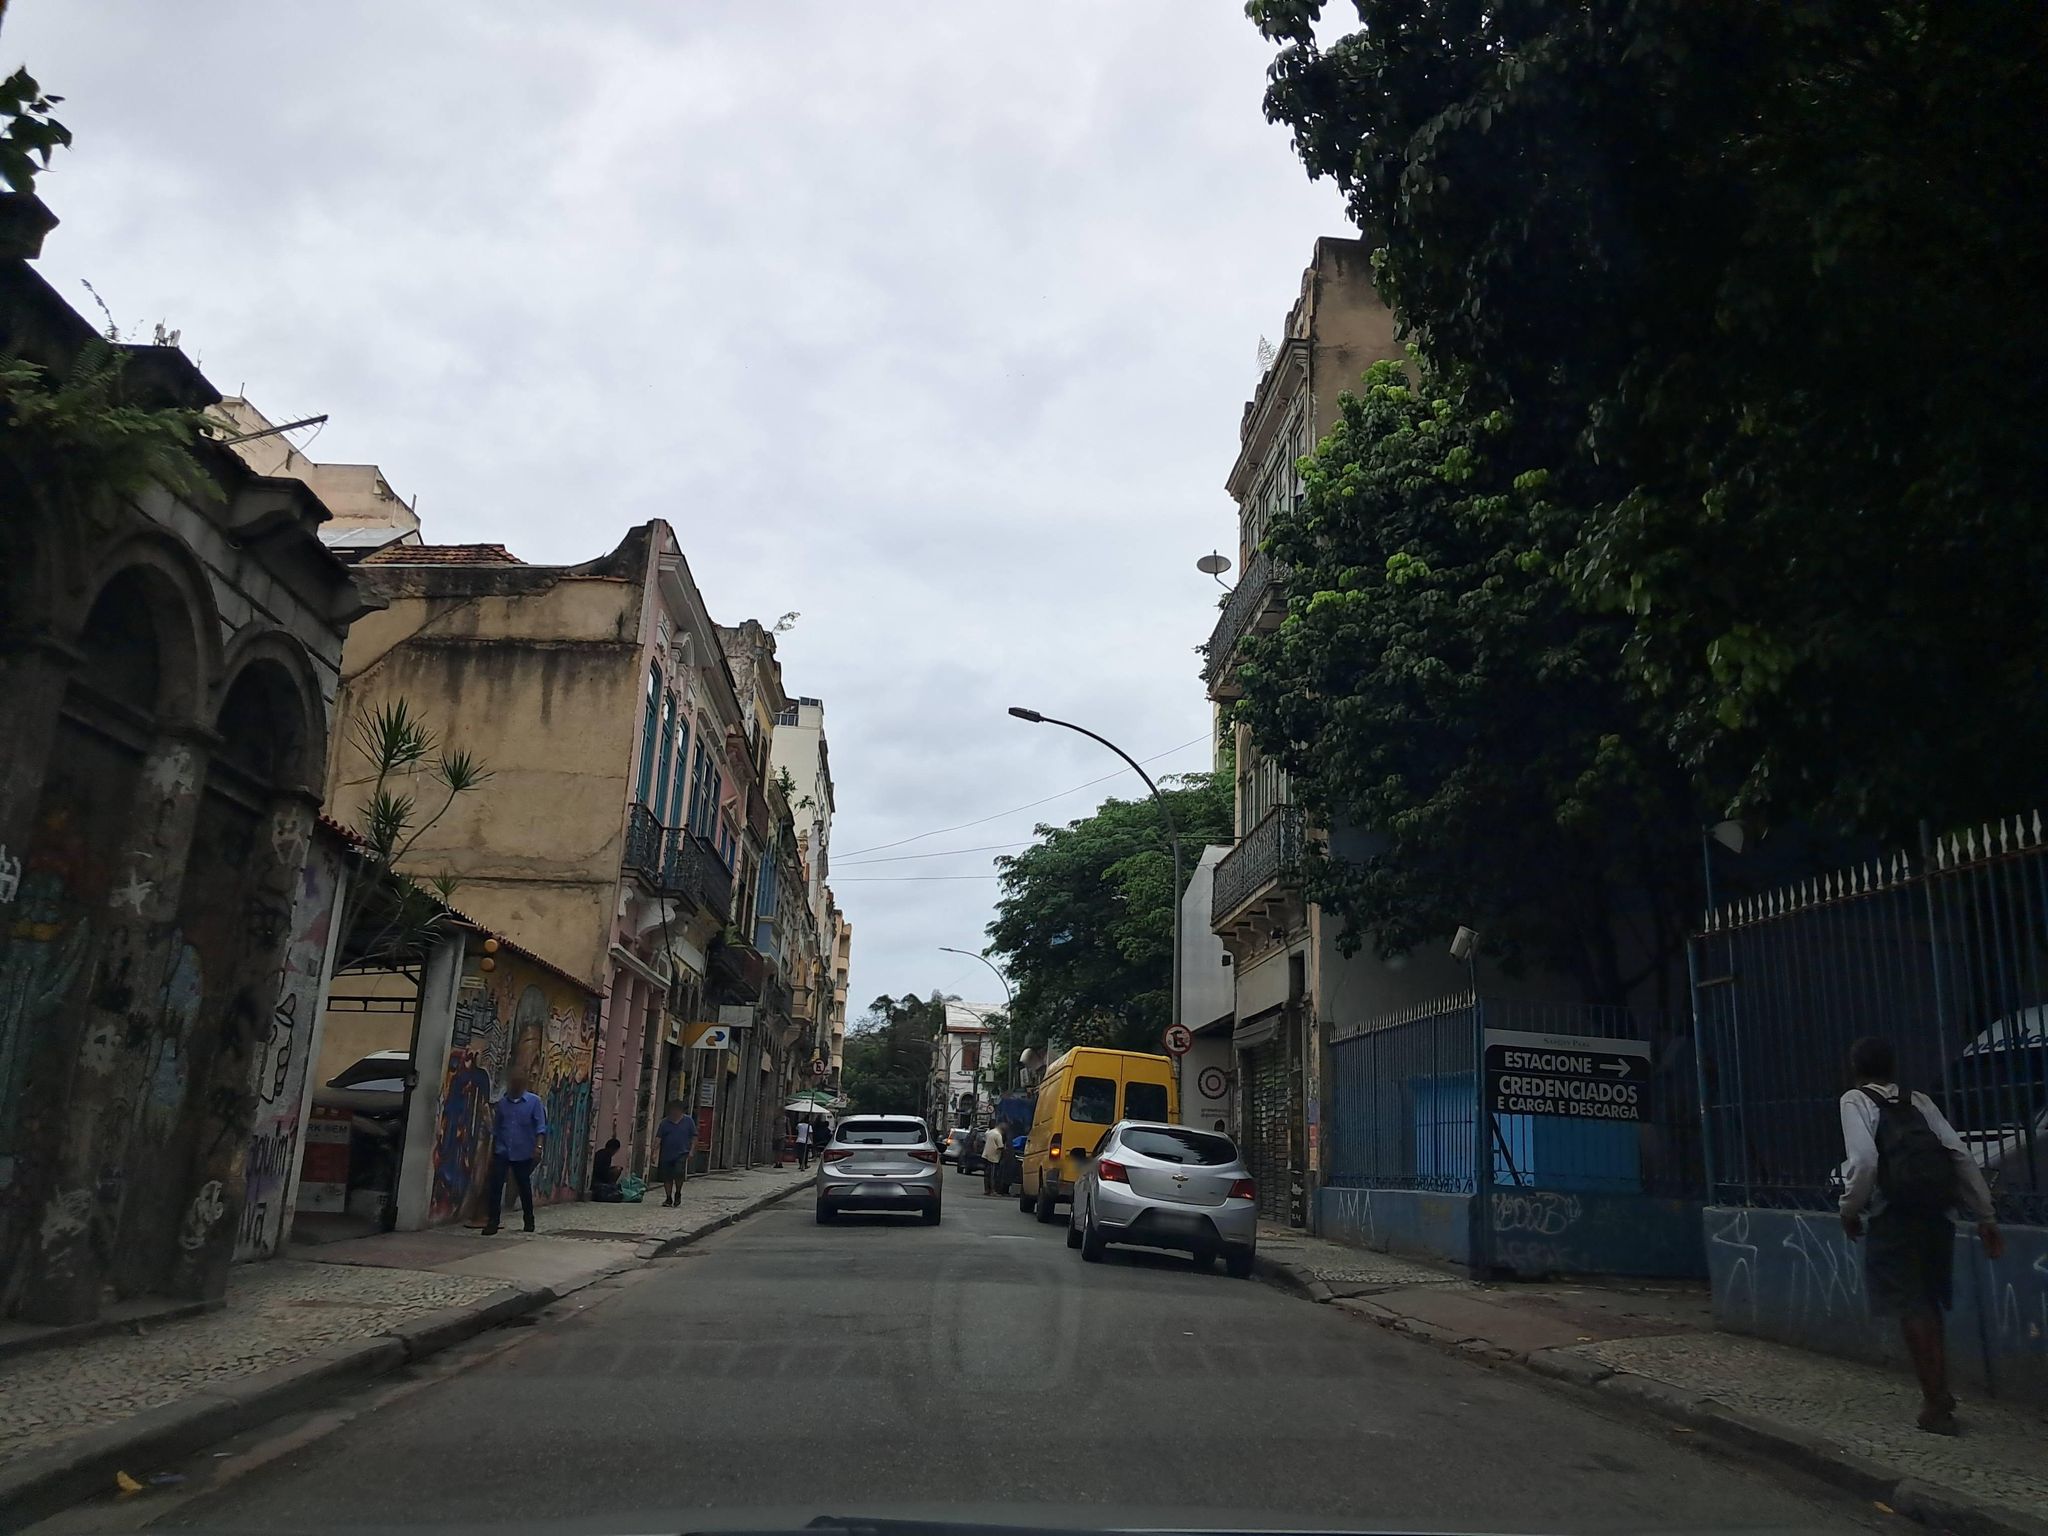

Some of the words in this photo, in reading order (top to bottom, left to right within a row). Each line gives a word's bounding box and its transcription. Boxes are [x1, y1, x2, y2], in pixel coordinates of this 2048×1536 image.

[1504, 1051, 1592, 1073] ESTACIONE
[1499, 1075, 1638, 1104] CREDENCIADOS
[1497, 1095, 1505, 1110] E
[1509, 1096, 1554, 1113] CARGA
[1558, 1100, 1566, 1114] E
[1569, 1101, 1639, 1120] DESCARGA
